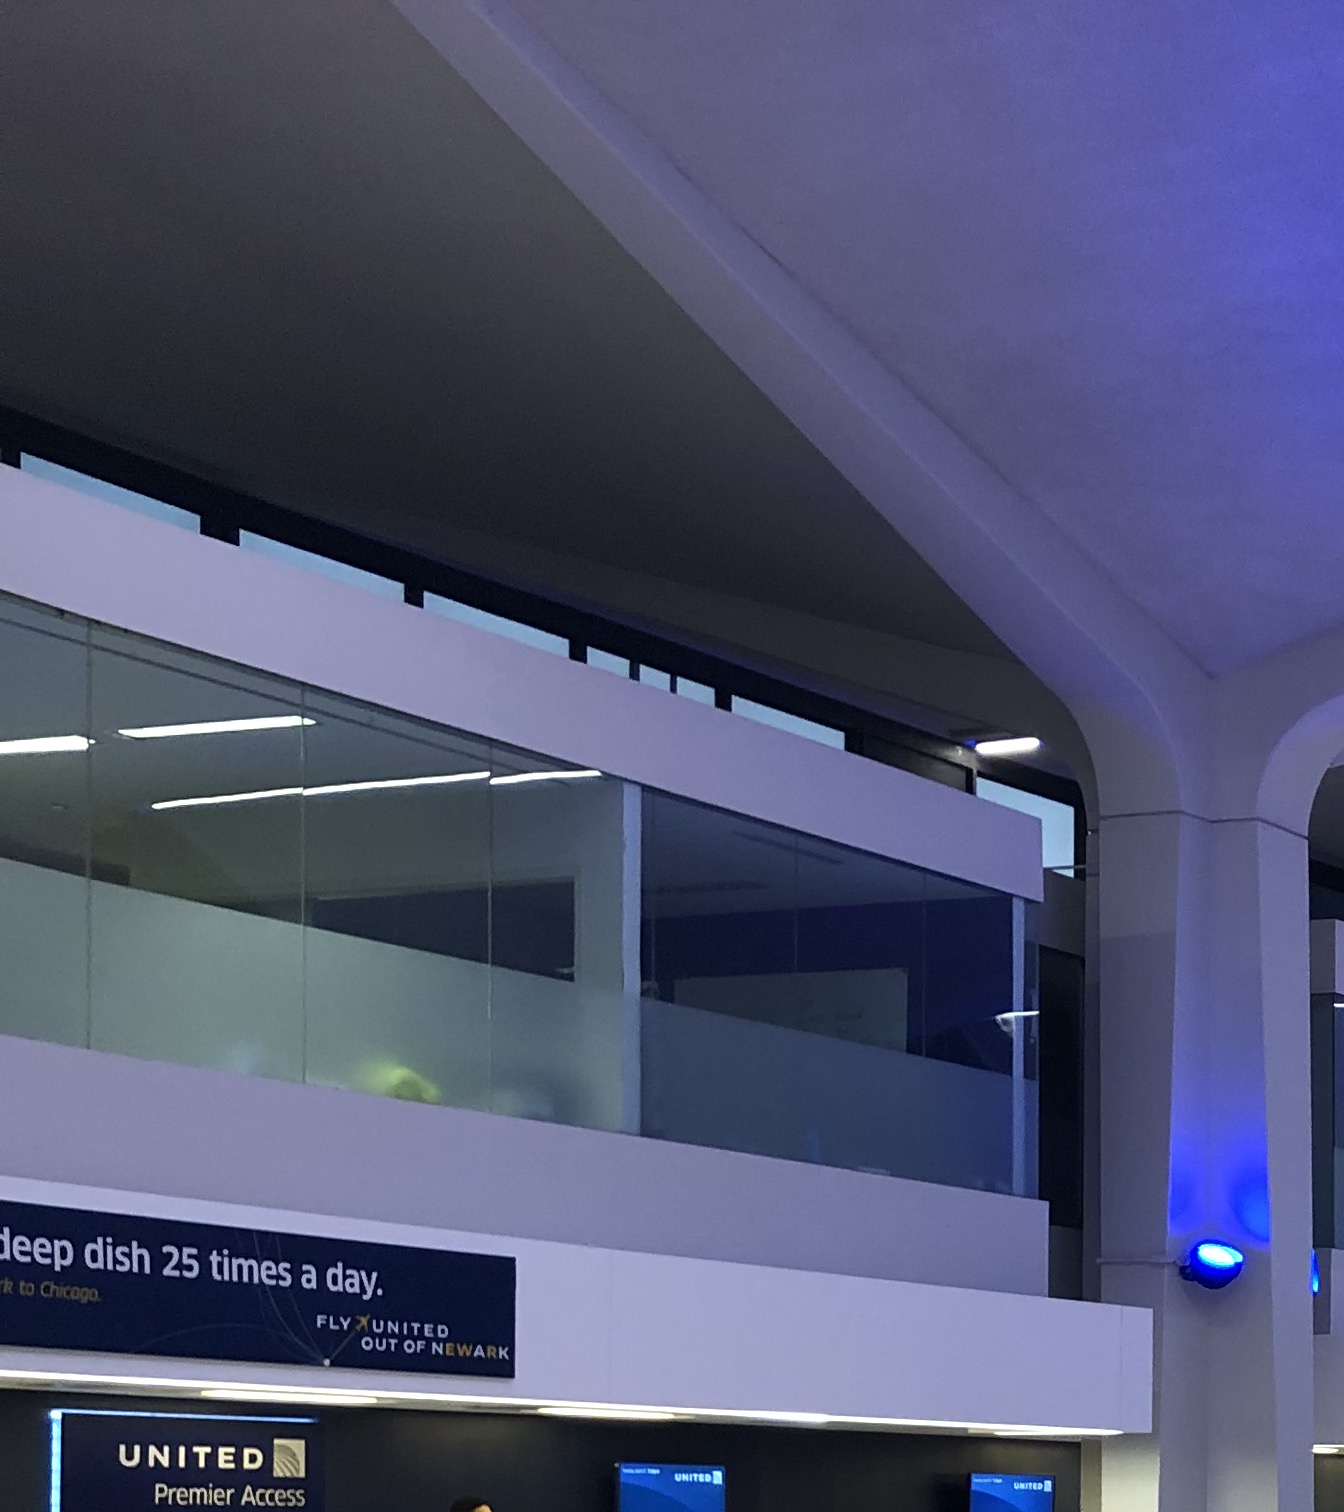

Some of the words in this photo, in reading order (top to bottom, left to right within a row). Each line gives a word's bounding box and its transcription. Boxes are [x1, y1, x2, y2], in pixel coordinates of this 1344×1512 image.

[0, 1226, 74, 1272] deep
[84, 1236, 151, 1274] dish
[161, 1245, 200, 1279] 25
[208, 1249, 292, 1287] times
[301, 1263, 317, 1290] a
[326, 1261, 383, 1300] day.
[20, 1281, 34, 1296] to
[316, 1314, 352, 1331] FLY
[372, 1319, 449, 1338] UNITED
[361, 1336, 399, 1352] OUT
[403, 1340, 426, 1354] OF
[432, 1341, 510, 1360] NEWARK
[119, 1444, 264, 1469] UNITED
[674, 1472, 712, 1482] UNITED
[1013, 1482, 1043, 1490] UNITED
[154, 1482, 235, 1506] Premier
[241, 1485, 306, 1507] Access
